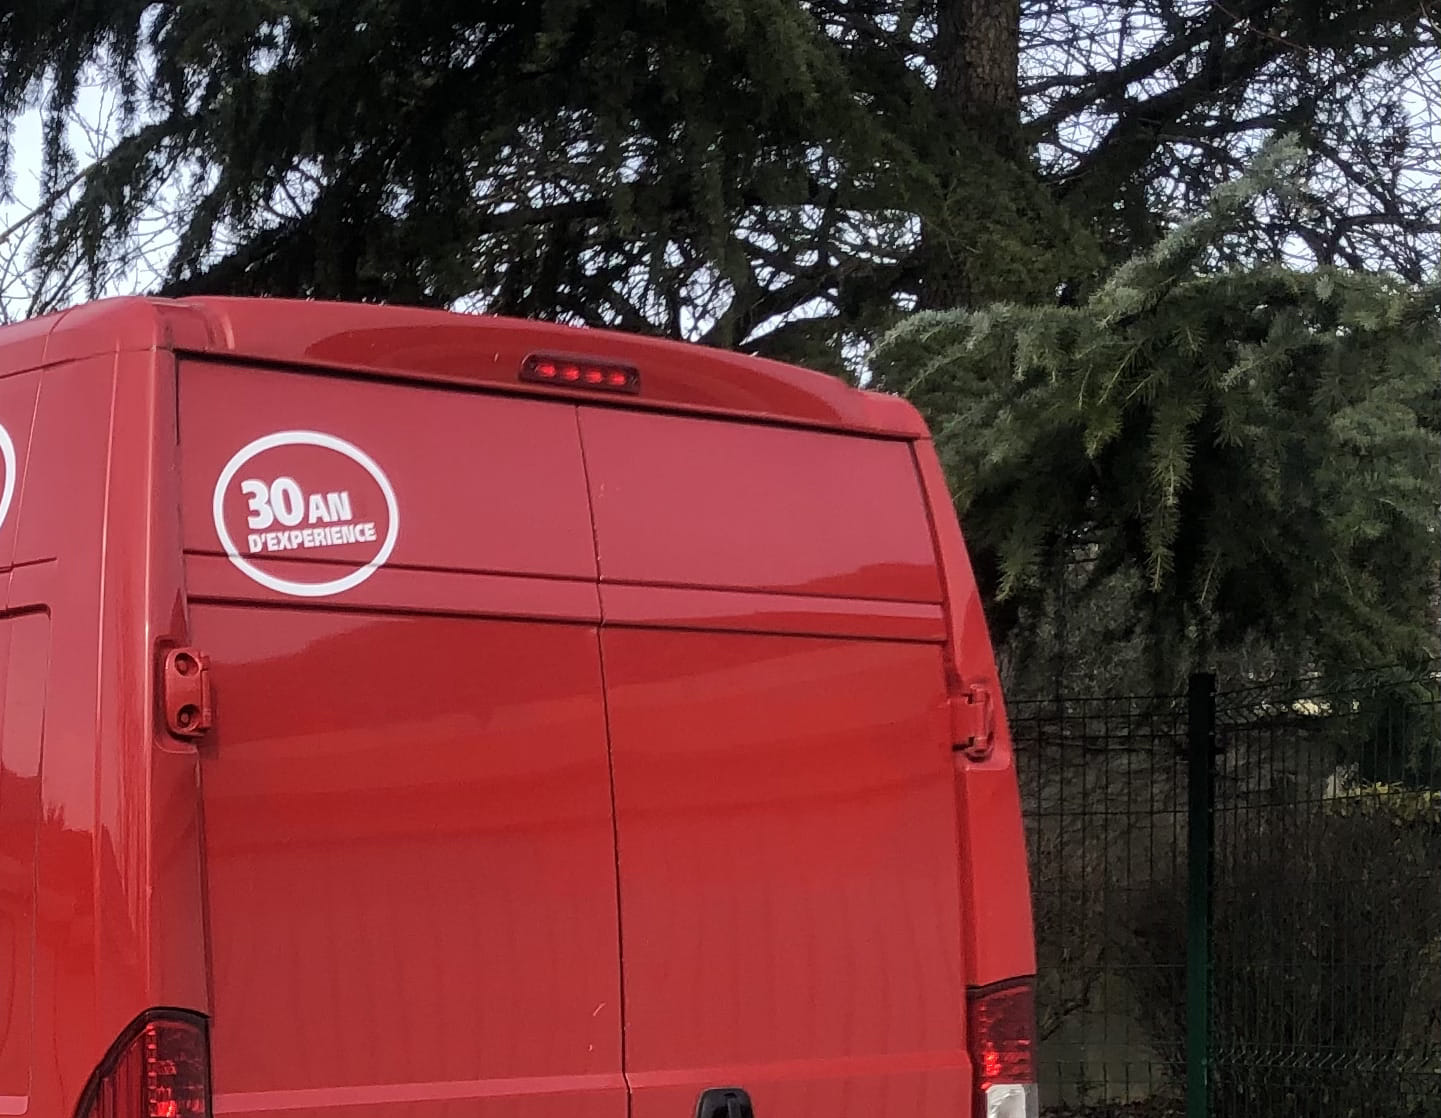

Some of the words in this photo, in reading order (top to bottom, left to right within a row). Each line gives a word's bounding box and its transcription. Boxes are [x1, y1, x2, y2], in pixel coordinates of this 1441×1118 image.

[241, 476, 304, 529] 30
[308, 491, 353, 524] AN
[247, 522, 377, 553] D'EXPERIENCE
